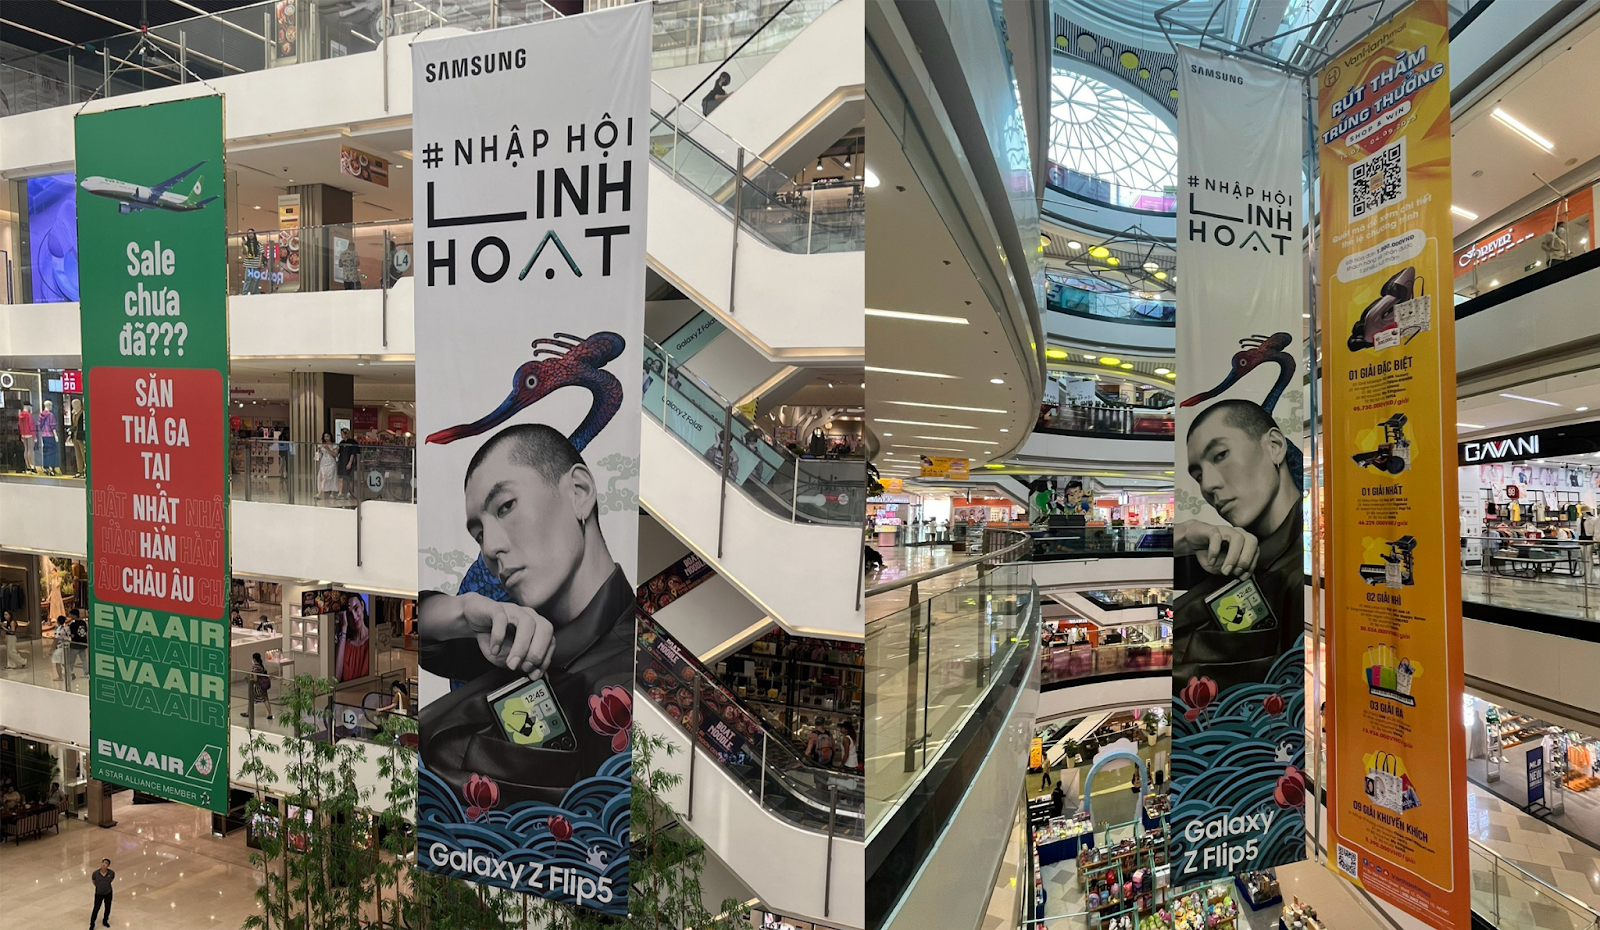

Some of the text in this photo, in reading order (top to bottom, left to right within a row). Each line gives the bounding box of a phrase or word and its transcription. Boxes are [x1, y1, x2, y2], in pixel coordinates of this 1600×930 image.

[425, 48, 527, 83] SAMSUNG
[1190, 63, 1244, 85] SAMSUNG
[1331, 86, 1366, 118] RÚT
[1369, 44, 1427, 93] THĂM
[567, 112, 633, 158] HỘI
[1321, 107, 1372, 145] TRÚNG
[1349, 125, 1373, 142] SHOP
[1385, 106, 1404, 121] WIN
[427, 160, 632, 228] LINH
[1262, 189, 1292, 208] HỘI
[1189, 192, 1292, 232] LINH
[1189, 219, 1292, 256] HOẠT
[126, 240, 176, 276] Sale
[396, 254, 408, 267] L4
[427, 225, 631, 287] HOẠT
[124, 282, 181, 317] chưa
[119, 321, 188, 357] đã???
[675, 330, 698, 351] Galaxy
[1348, 356, 1413, 381] 01 GIẢI ĐẶC BIỆT
[135, 372, 174, 408] SĂN
[121, 407, 190, 447] THẢ GA
[661, 395, 683, 417] Galaxy
[681, 412, 687, 420] Z
[685, 416, 703, 432] Fold5
[1465, 434, 1540, 463] GAVANI
[141, 451, 171, 490] TẠI
[369, 475, 382, 487] L3
[1372, 484, 1385, 496] GIẢI
[133, 489, 180, 532] NHẬT
[140, 526, 176, 562] HÀN
[122, 563, 167, 598] CHÂU
[170, 567, 194, 603] ÂU
[1236, 586, 1253, 599] 12:45
[656, 641, 680, 665] NOODLE
[525, 689, 545, 703] 12:45
[343, 713, 355, 725] L2
[716, 721, 736, 740] BOAT
[707, 724, 734, 751] NOODLE
[1529, 758, 1542, 770] MLB
[1529, 769, 1542, 783] NEW
[98, 768, 197, 801] A STAR ALLIANCE MEMBER
[1184, 810, 1275, 843] Galaxy
[429, 841, 614, 906] Galaxy Z Flip5
[1183, 838, 1259, 875] Z Flip5
